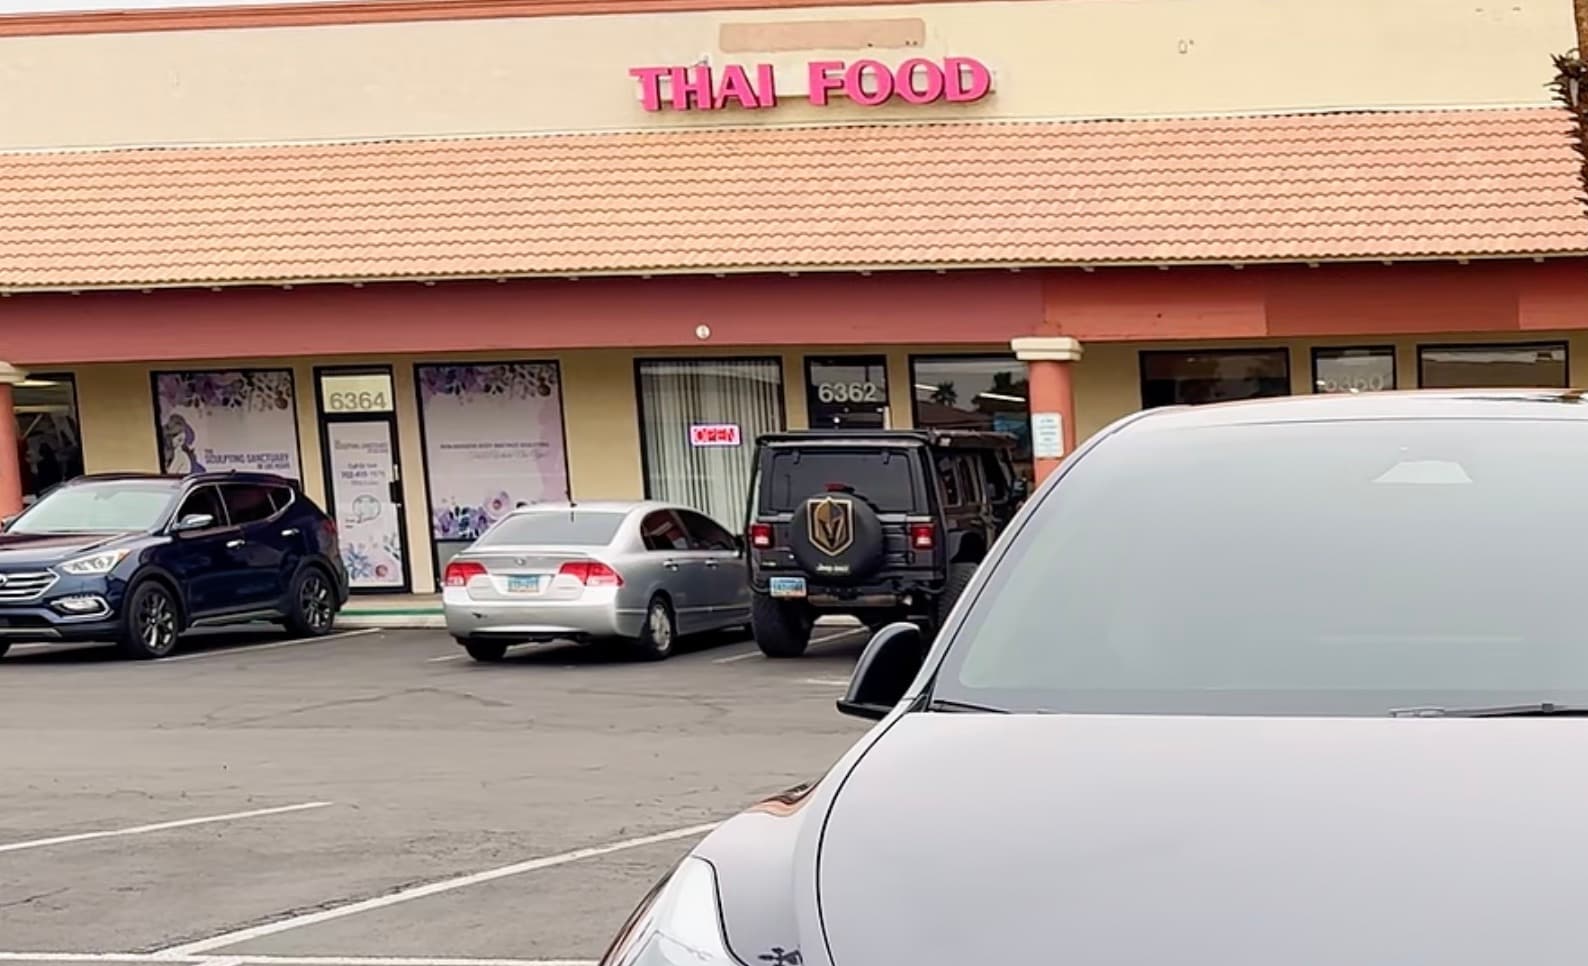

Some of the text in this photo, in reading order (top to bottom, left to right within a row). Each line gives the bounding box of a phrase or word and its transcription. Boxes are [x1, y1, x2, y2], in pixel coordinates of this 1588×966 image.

[629, 57, 991, 111] THAI FOOD
[330, 392, 386, 410] 6364
[818, 383, 877, 403] 6362
[693, 427, 736, 443] OPEN
